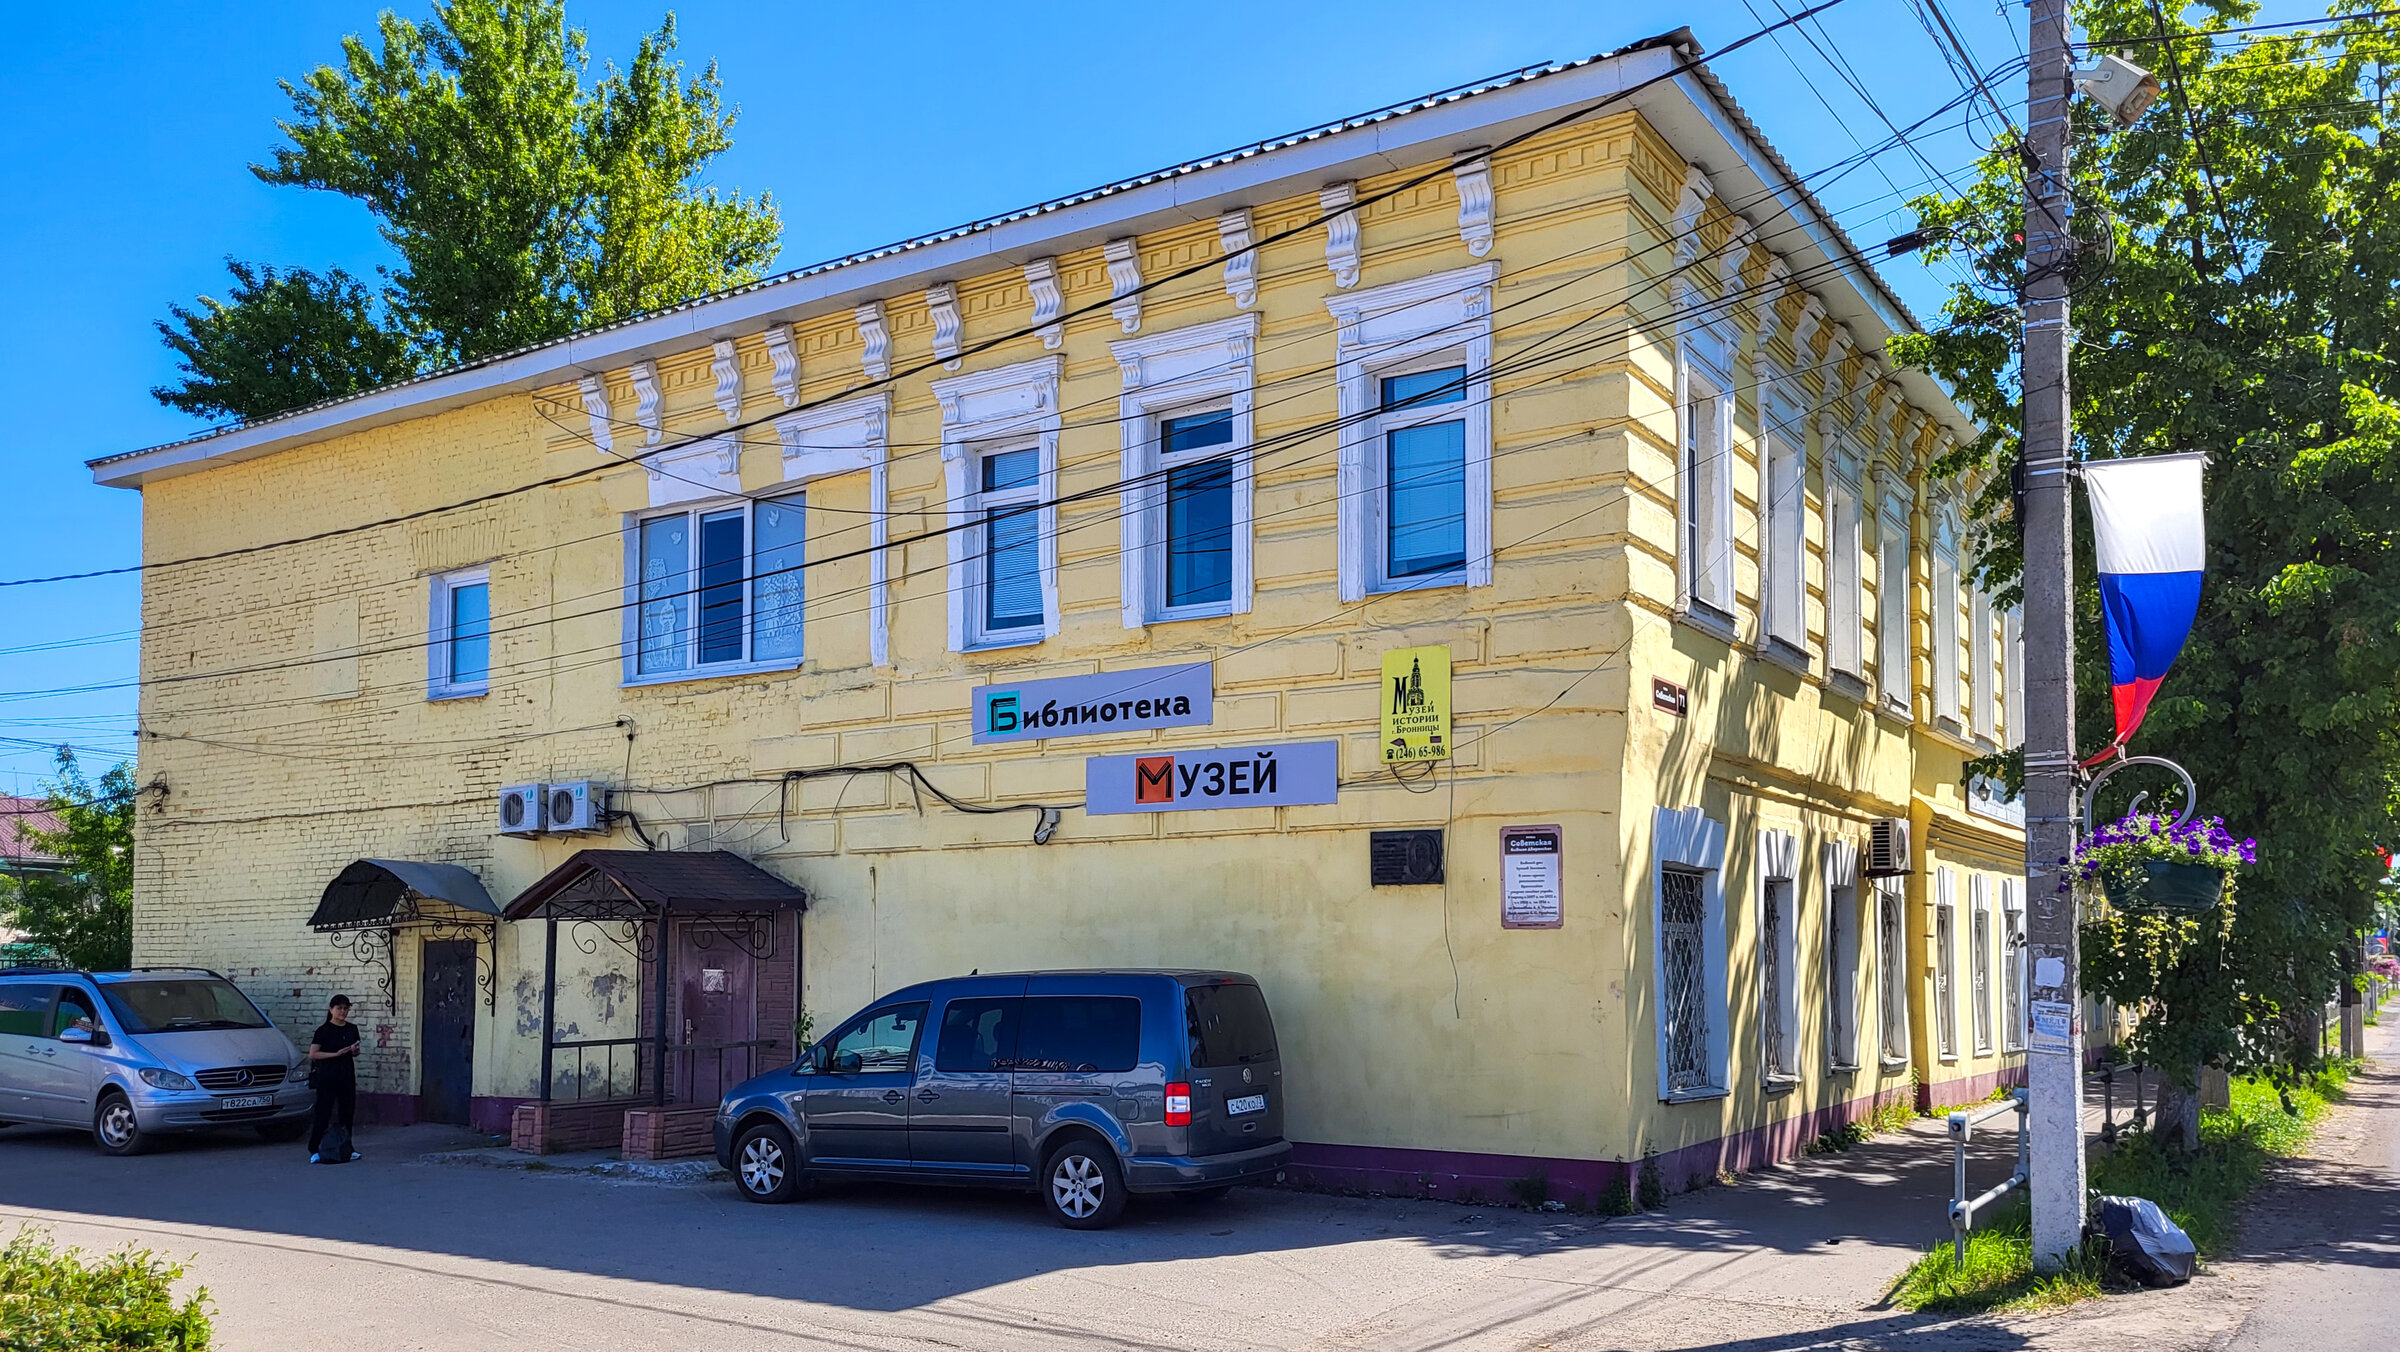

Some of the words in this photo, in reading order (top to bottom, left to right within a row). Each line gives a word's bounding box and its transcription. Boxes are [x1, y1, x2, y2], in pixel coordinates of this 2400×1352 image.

[990, 695, 1191, 733] Библиотека
[1392, 714, 1439, 726] ИСТОРИИ
[1418, 744, 1446, 758] 65-986
[1137, 751, 1277, 800] МУЗЕЙ
